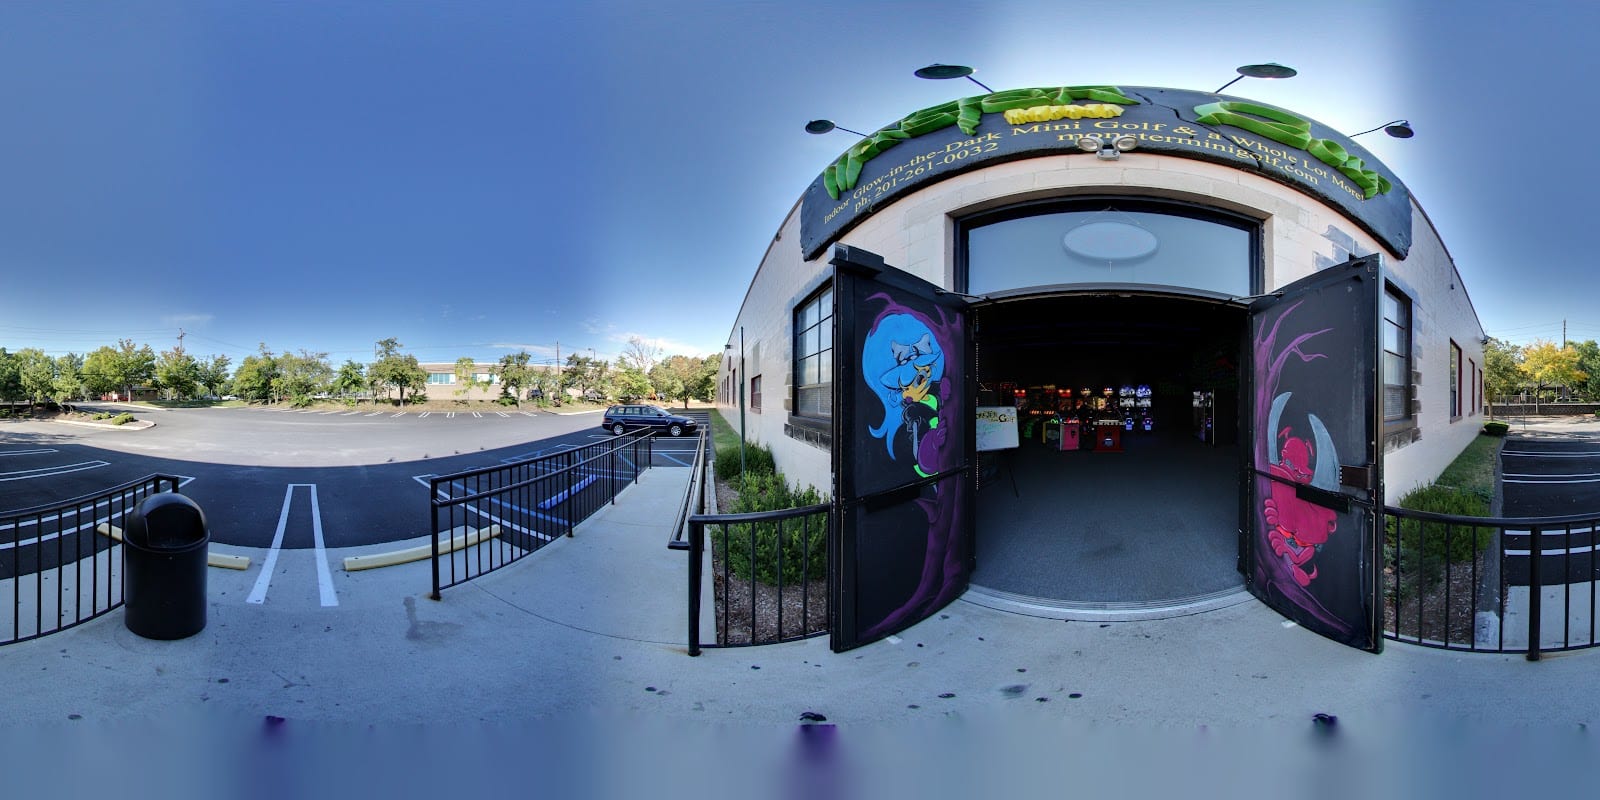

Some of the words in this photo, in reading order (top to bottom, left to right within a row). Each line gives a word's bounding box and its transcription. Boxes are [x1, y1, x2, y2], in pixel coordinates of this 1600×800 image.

[823, 198, 850, 224] Indoor
[853, 132, 1002, 200] Glow-in-the-Dark
[1011, 122, 1081, 136] Mini
[1094, 121, 1168, 131] Golf
[1172, 126, 1199, 136] &
[1207, 132, 1221, 140] a
[1230, 134, 1297, 163] Whole
[1303, 159, 1329, 179] Lot
[1332, 174, 1365, 203] More!
[854, 194, 871, 213] ph:
[874, 142, 999, 199] 201-261-0032
